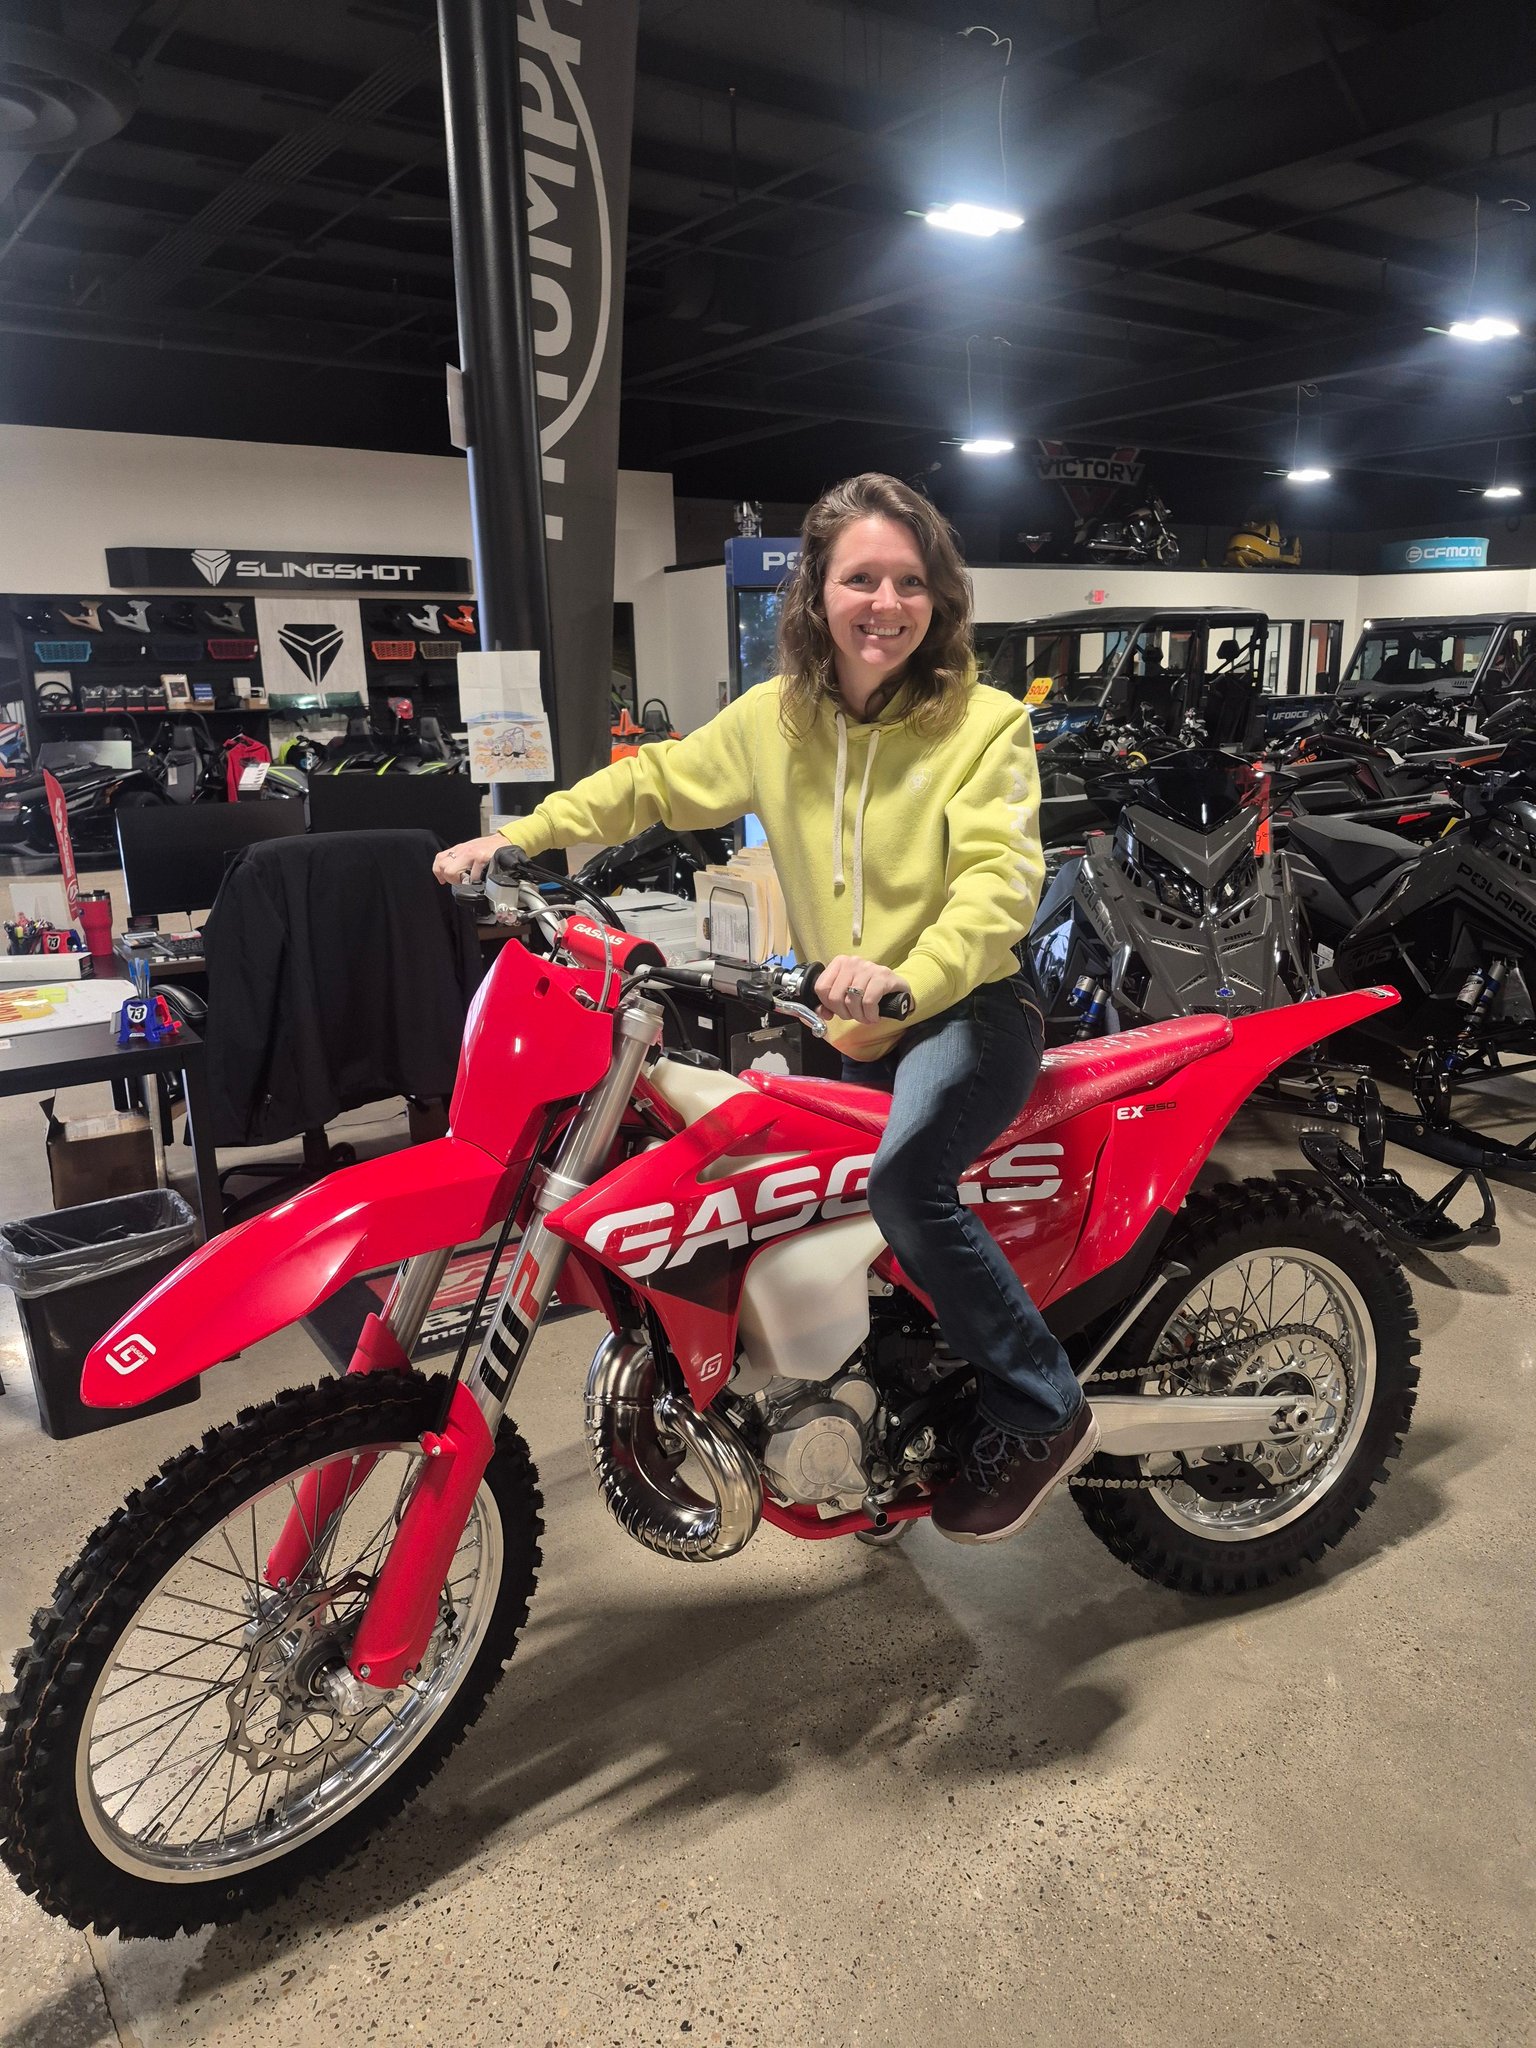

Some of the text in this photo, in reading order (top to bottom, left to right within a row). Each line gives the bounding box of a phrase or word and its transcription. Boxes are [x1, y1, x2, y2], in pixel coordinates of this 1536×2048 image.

[1039, 458, 1140, 482] VICTORY
[1423, 546, 1482, 559] CFMOTO
[236, 561, 421, 581] SLINGSHOT
[1029, 685, 1049, 696] SOLD
[1272, 710, 1309, 720] UFORCE
[130, 1007, 145, 1020] 73
[1116, 1101, 1177, 1121] EX 250
[584, 1142, 1065, 1279] GASGS
